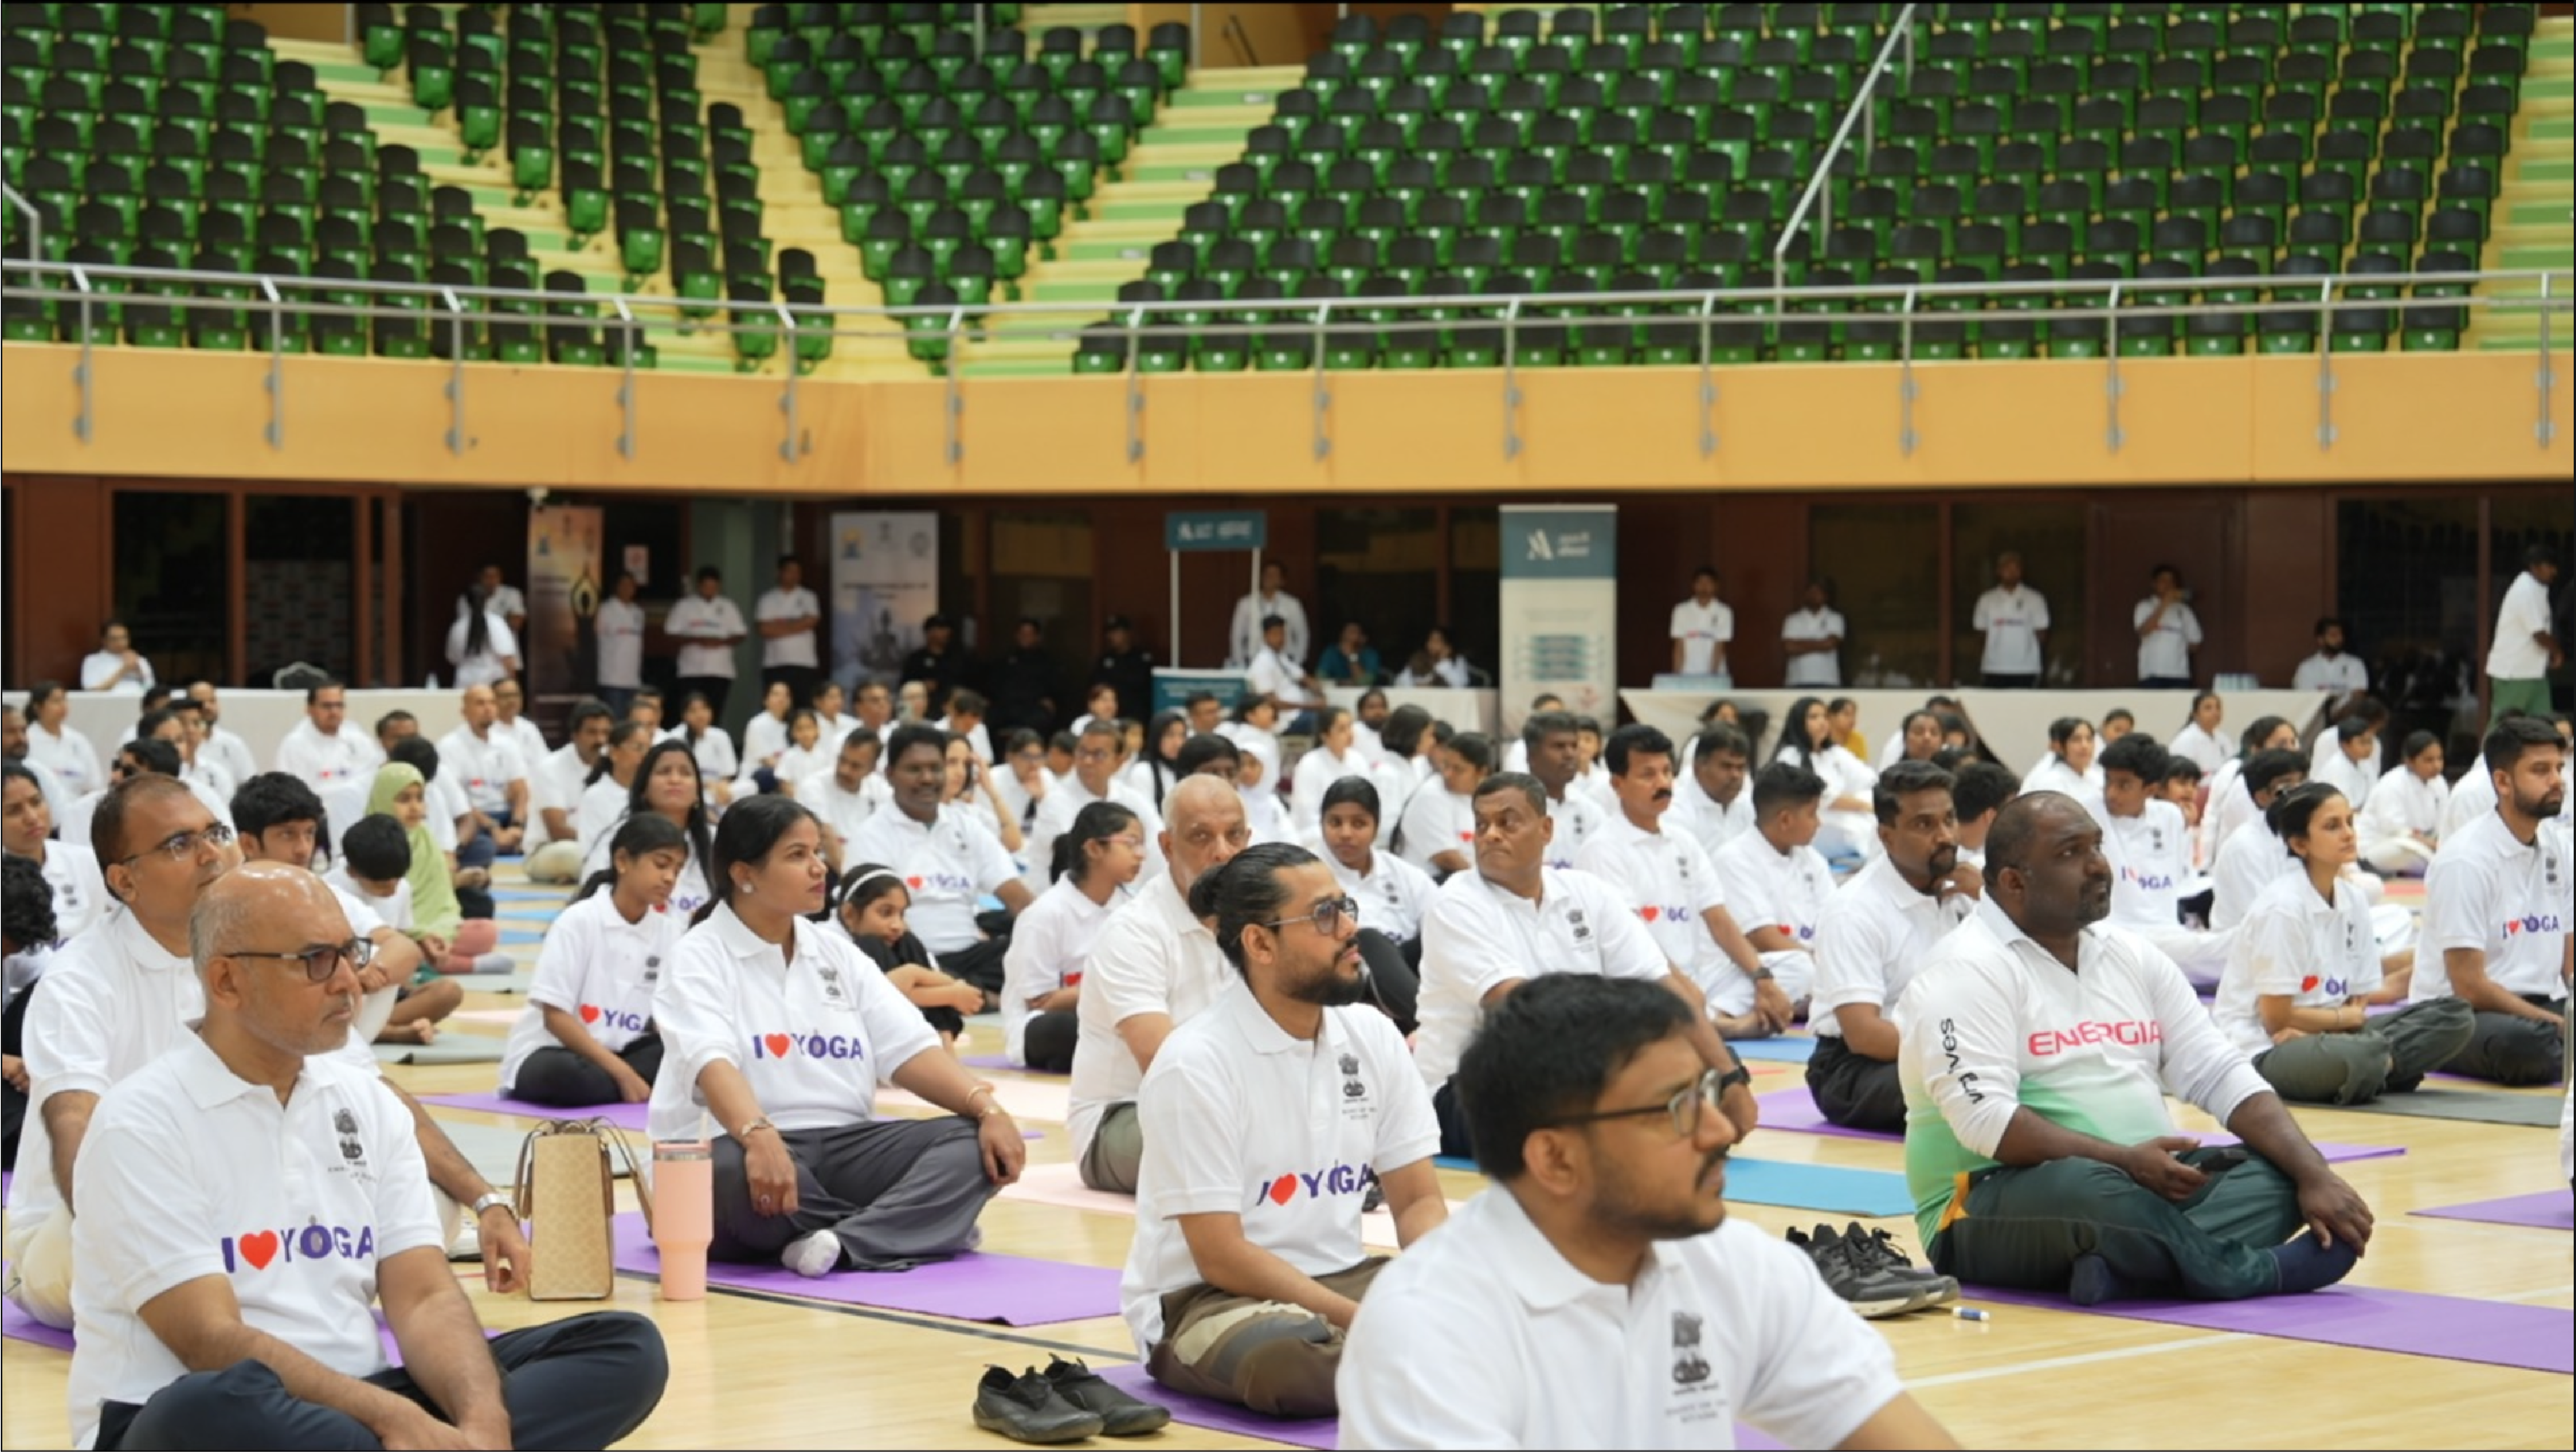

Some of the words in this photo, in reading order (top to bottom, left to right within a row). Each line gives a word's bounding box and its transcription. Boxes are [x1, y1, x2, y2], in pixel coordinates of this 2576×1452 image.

[753, 1035, 763, 1059] I
[790, 1033, 864, 1061] YOGA
[221, 1237, 235, 1273] I
[279, 1224, 374, 1263] YOGA
